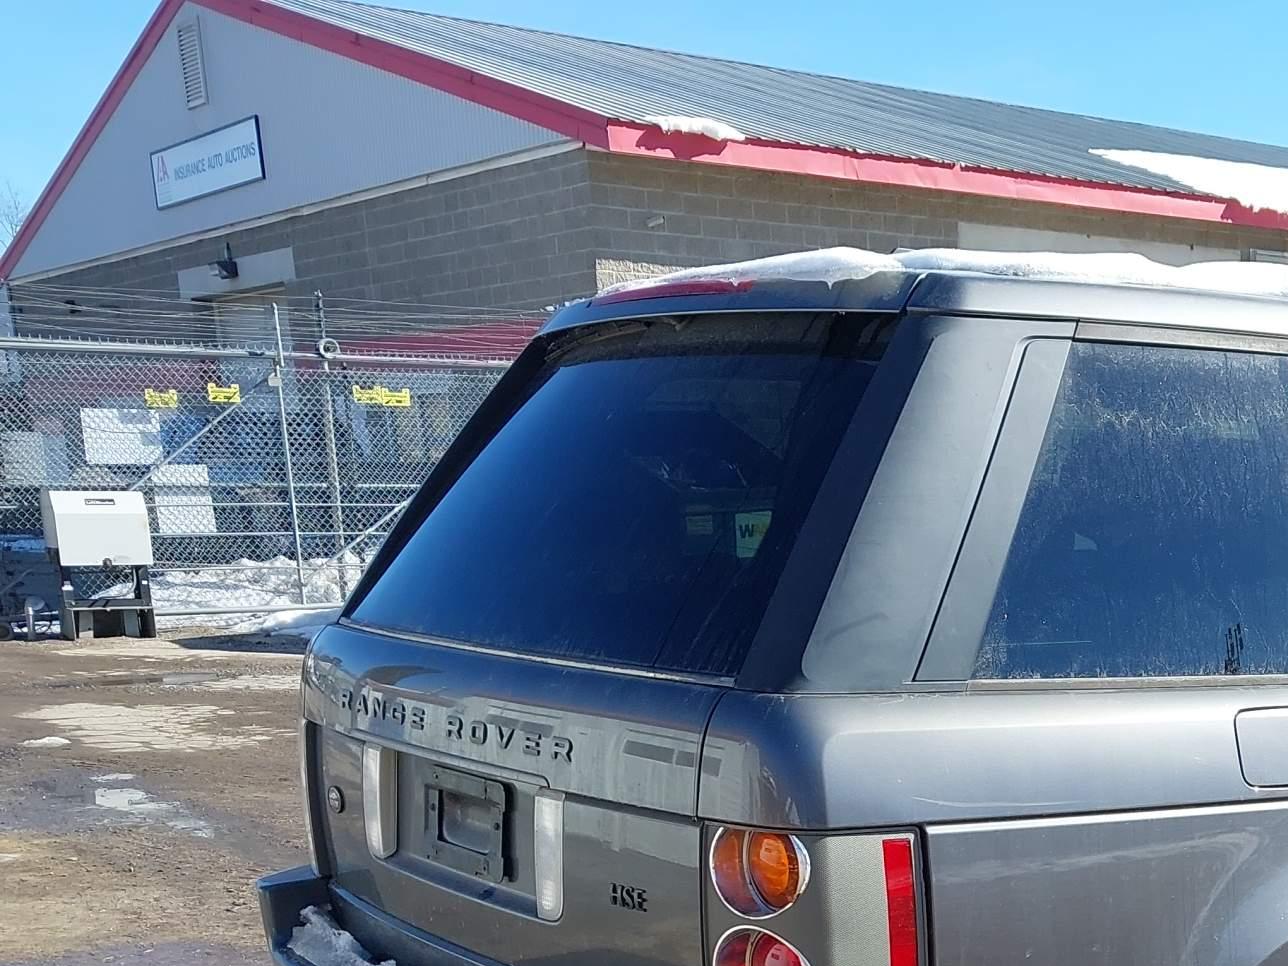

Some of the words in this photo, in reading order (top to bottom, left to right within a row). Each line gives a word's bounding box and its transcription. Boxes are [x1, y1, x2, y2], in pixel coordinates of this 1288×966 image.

[174, 158, 206, 181] INSURANCE
[207, 152, 223, 171] AUTO
[225, 142, 256, 164] AUCTIONS
[339, 689, 426, 731] RANGE
[446, 714, 574, 763] ROVER
[609, 882, 648, 912] HSE
